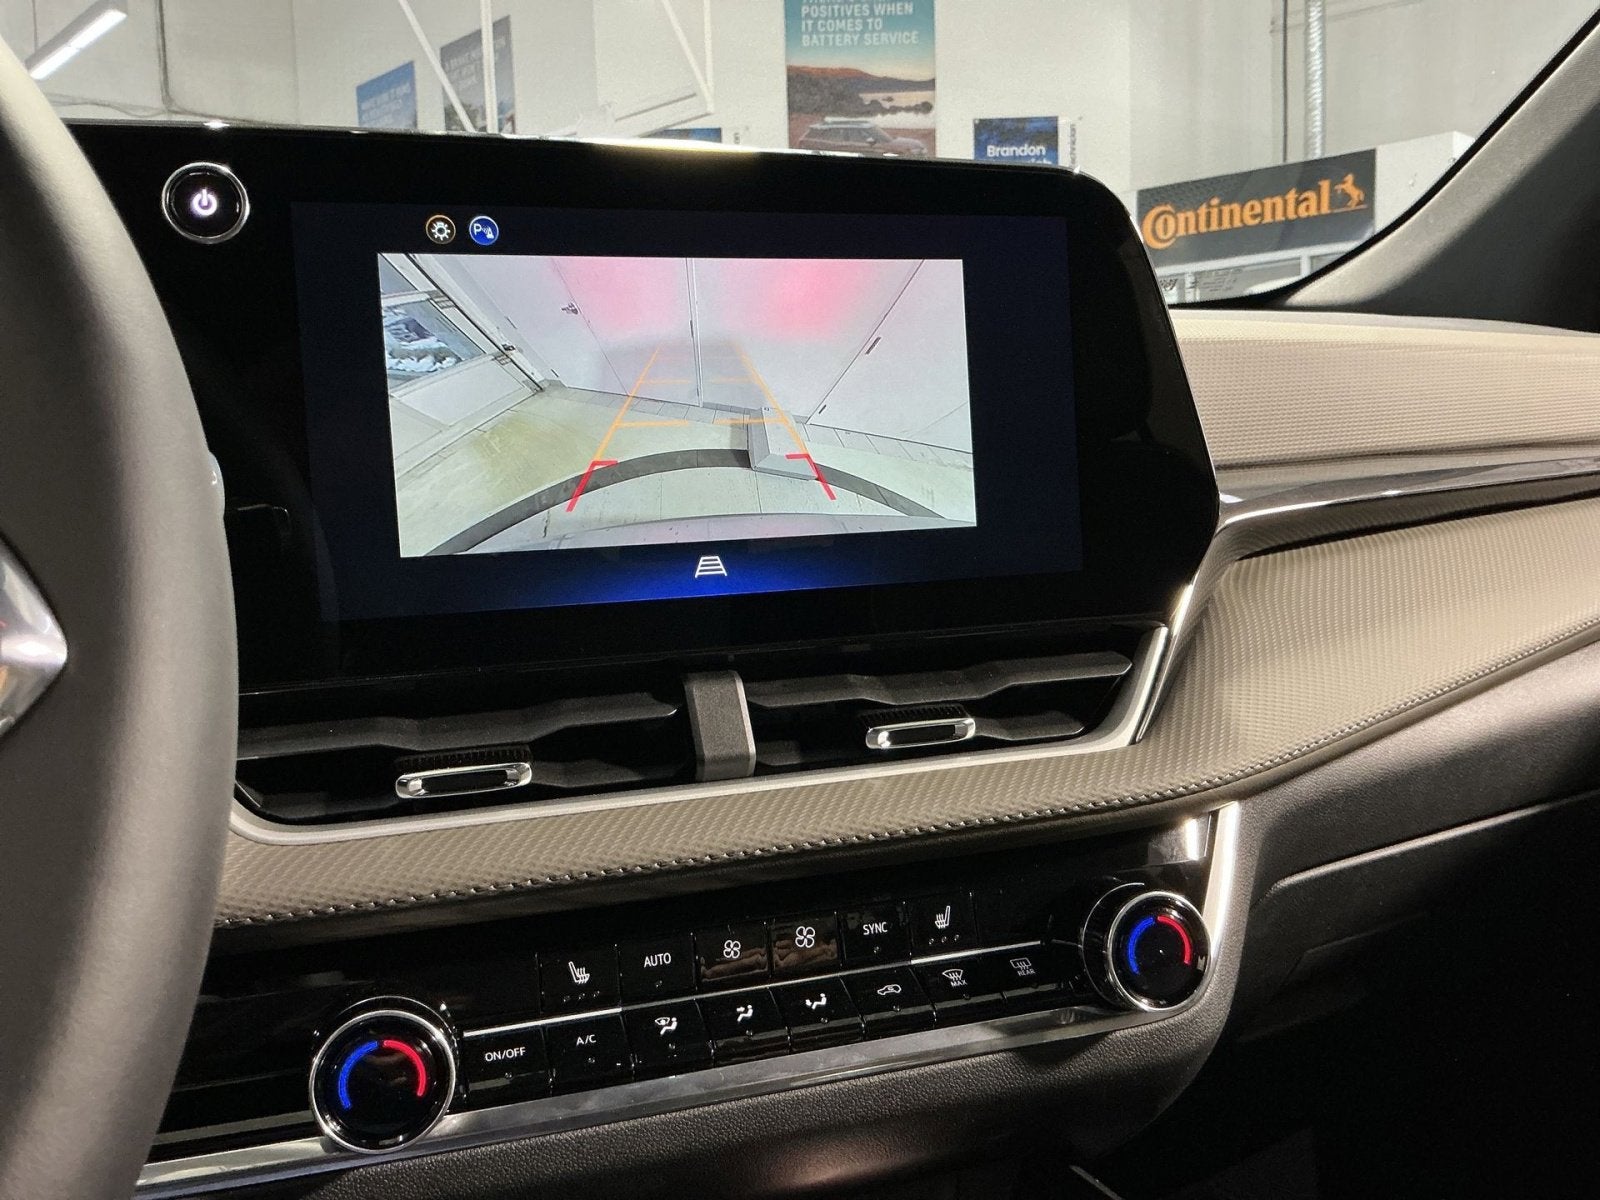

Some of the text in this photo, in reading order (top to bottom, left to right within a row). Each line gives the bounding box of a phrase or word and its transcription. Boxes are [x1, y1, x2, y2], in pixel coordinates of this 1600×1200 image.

[801, 2, 913, 18] POSITIVES WHEN
[801, 18, 883, 32] IT COMES TO
[802, 31, 919, 47] BATTERY SERVICE
[986, 144, 1046, 157] Brandon
[1142, 179, 1331, 249] Continental
[862, 921, 888, 936] SYNC
[643, 952, 672, 968] AUTO
[1017, 968, 1036, 976] REAR
[950, 979, 968, 987] MAX
[576, 1034, 597, 1047] A/C
[484, 1046, 526, 1062] ON/OFF
